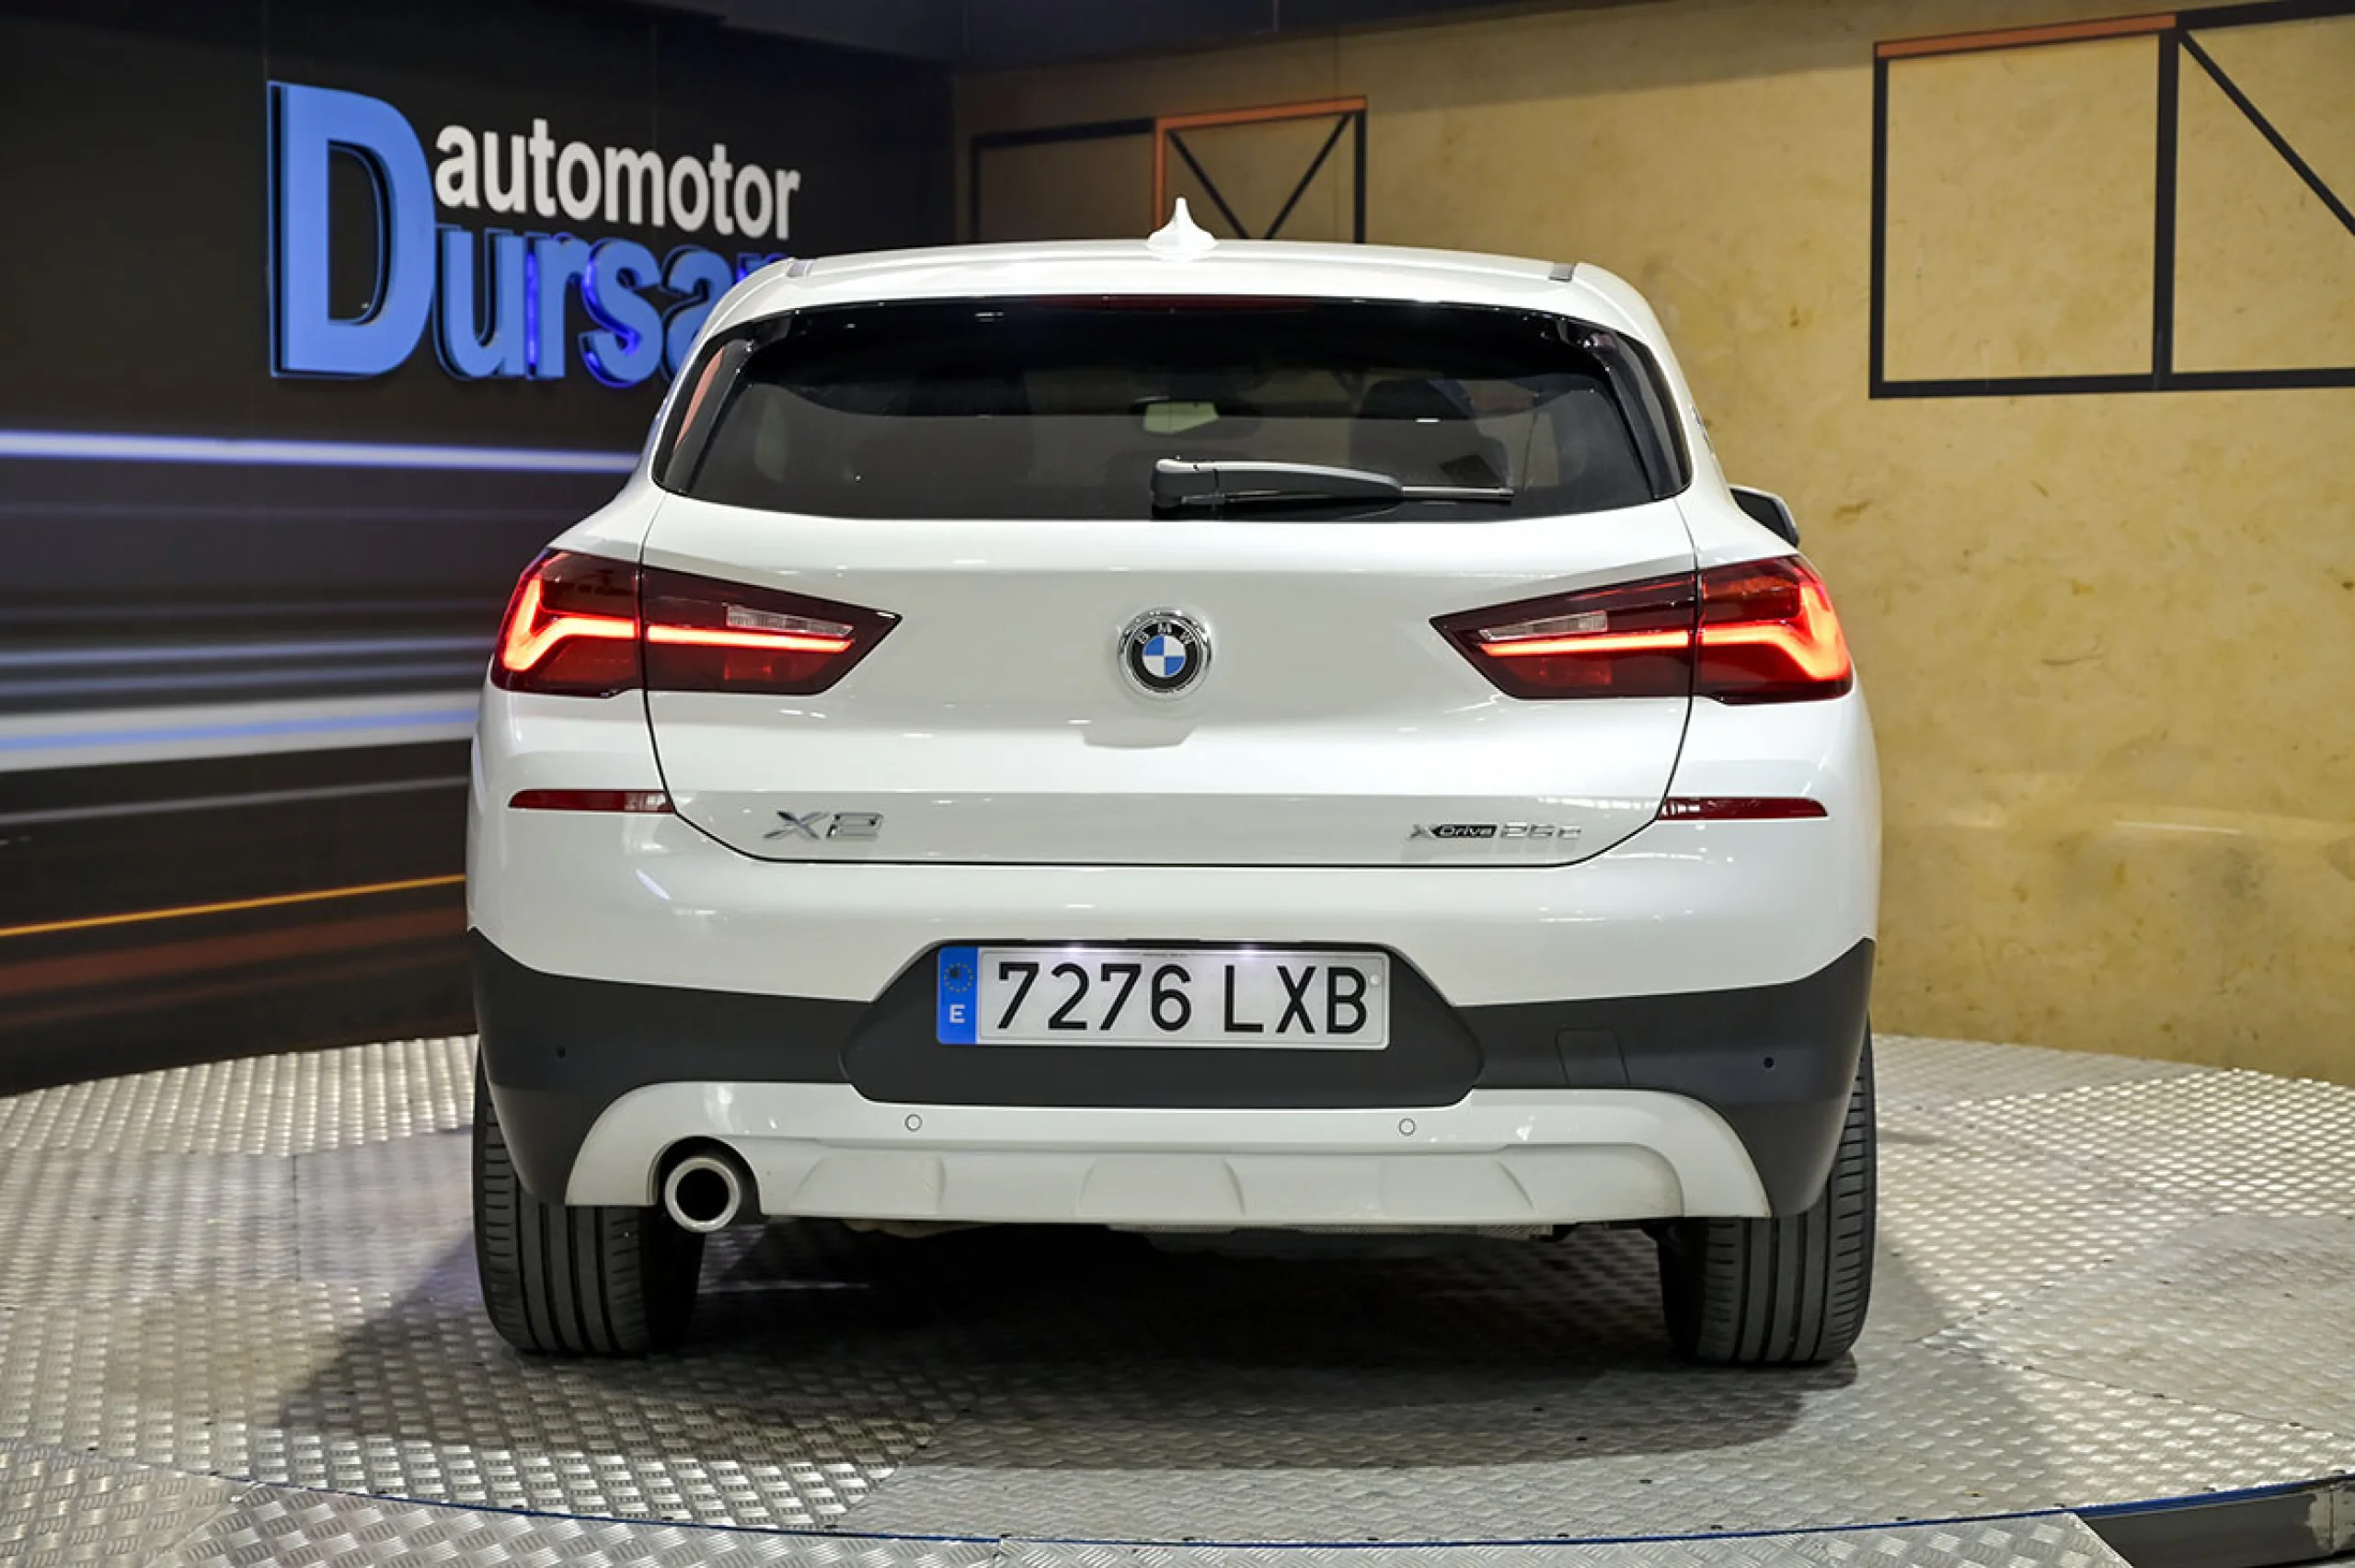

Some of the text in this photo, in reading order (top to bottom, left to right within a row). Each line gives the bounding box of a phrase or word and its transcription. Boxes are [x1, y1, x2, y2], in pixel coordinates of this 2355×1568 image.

[435, 119, 801, 241] automotor
[267, 80, 789, 387] Dursa
[763, 810, 884, 841] X2
[948, 1004, 965, 1024] E
[996, 961, 1368, 1035] 7276 LXB
